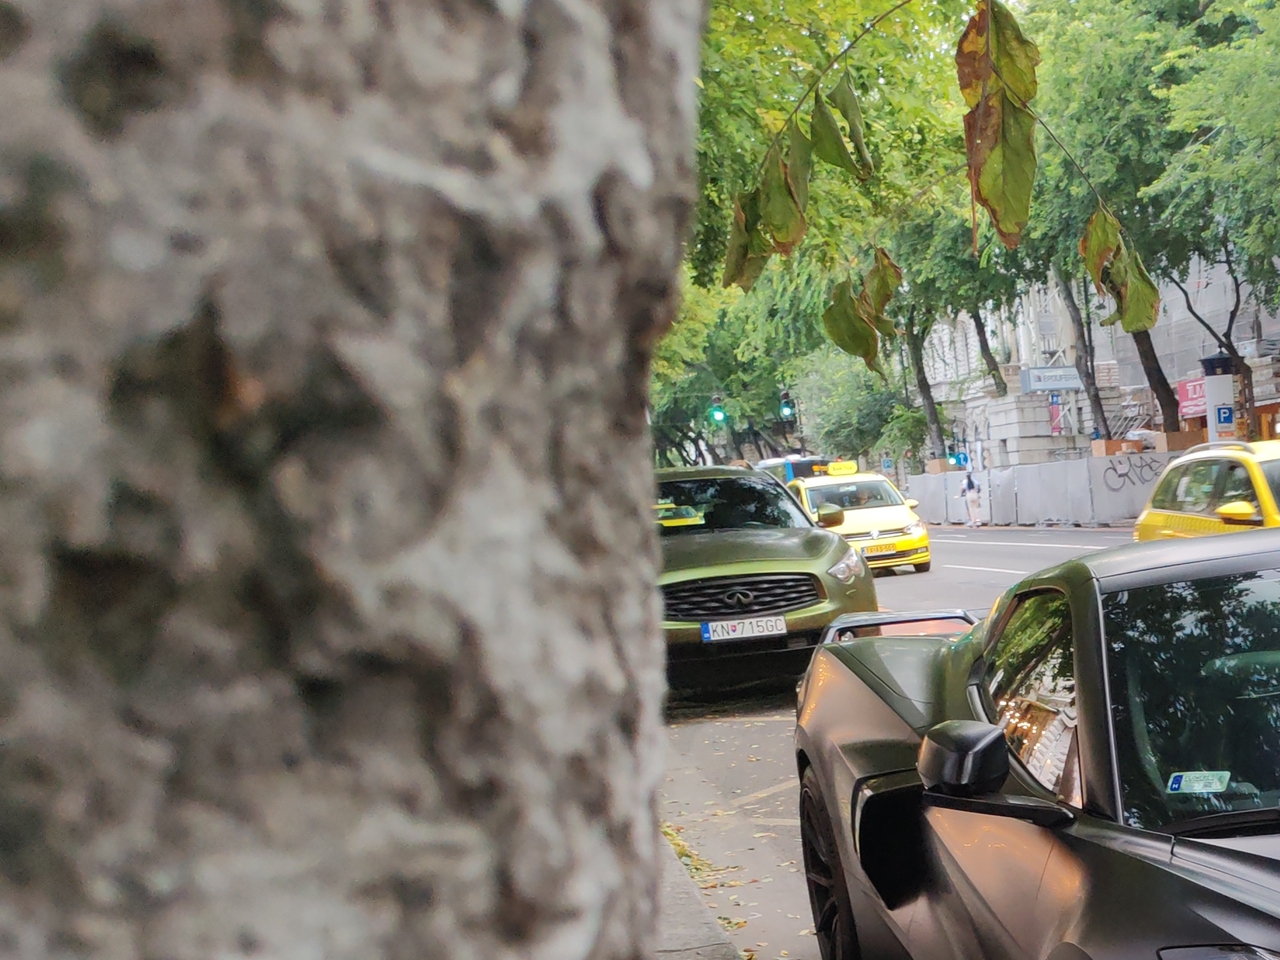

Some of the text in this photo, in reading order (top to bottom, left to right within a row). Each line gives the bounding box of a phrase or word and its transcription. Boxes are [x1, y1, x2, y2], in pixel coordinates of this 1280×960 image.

[1219, 409, 1230, 422] P
[710, 618, 784, 638] KN 715GC
